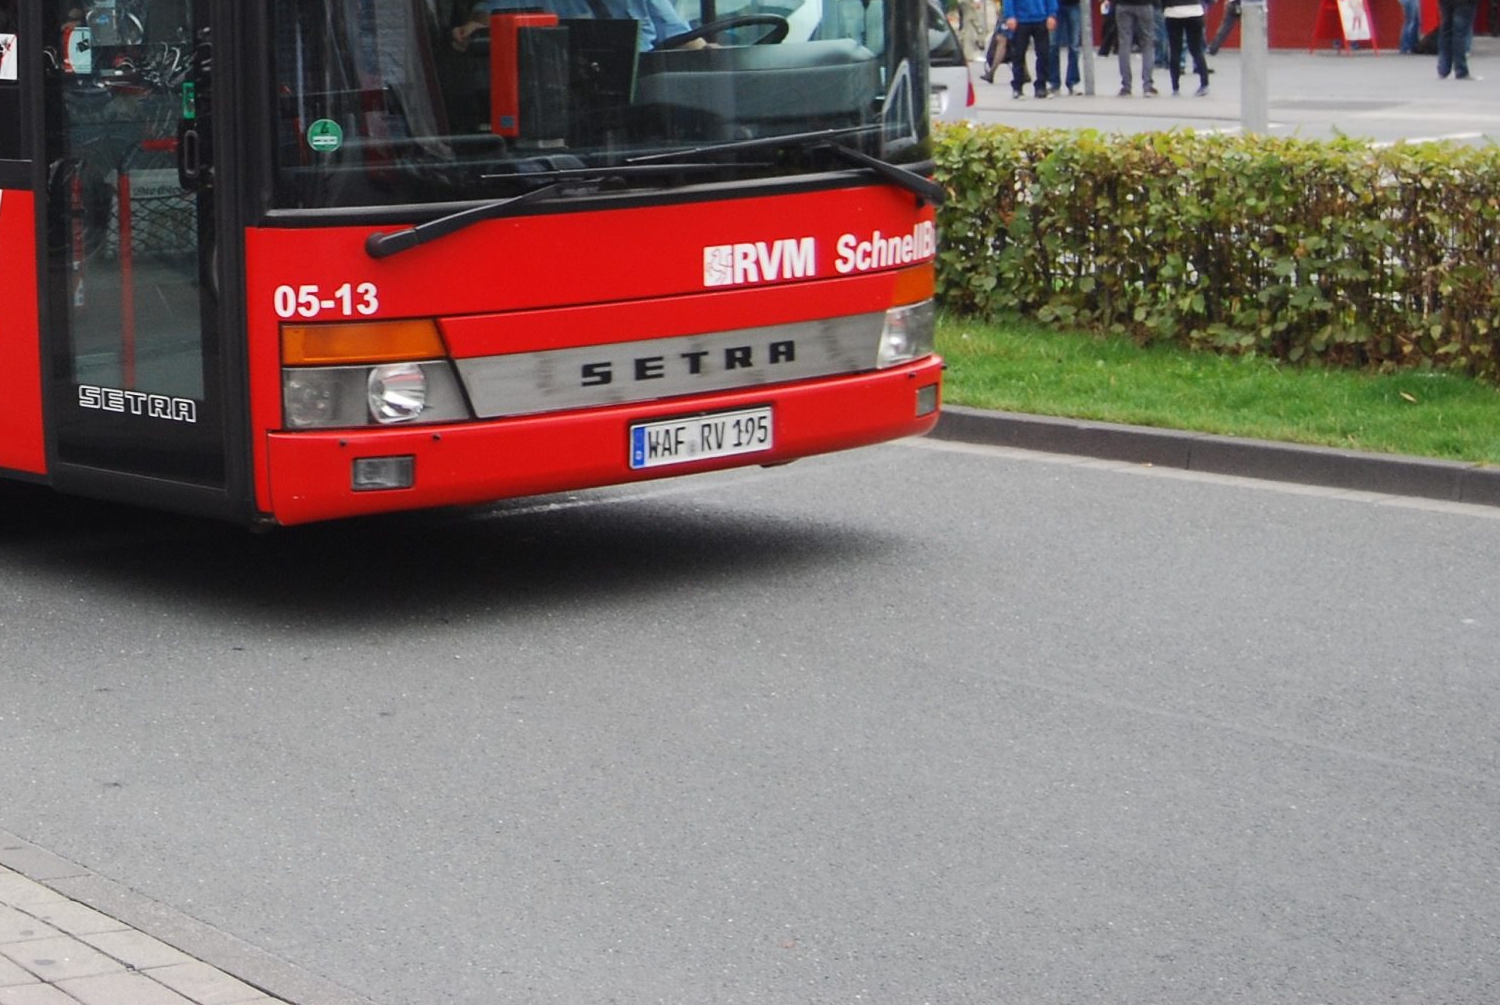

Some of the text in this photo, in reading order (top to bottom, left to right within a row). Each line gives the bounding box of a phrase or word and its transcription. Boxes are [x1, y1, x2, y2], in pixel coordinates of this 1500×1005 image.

[731, 221, 937, 284] RVM SchnellB
[273, 282, 380, 319] 05-13
[581, 339, 796, 388] SETRA
[78, 384, 197, 424] SETRA
[647, 415, 769, 460] WAF RV 195
